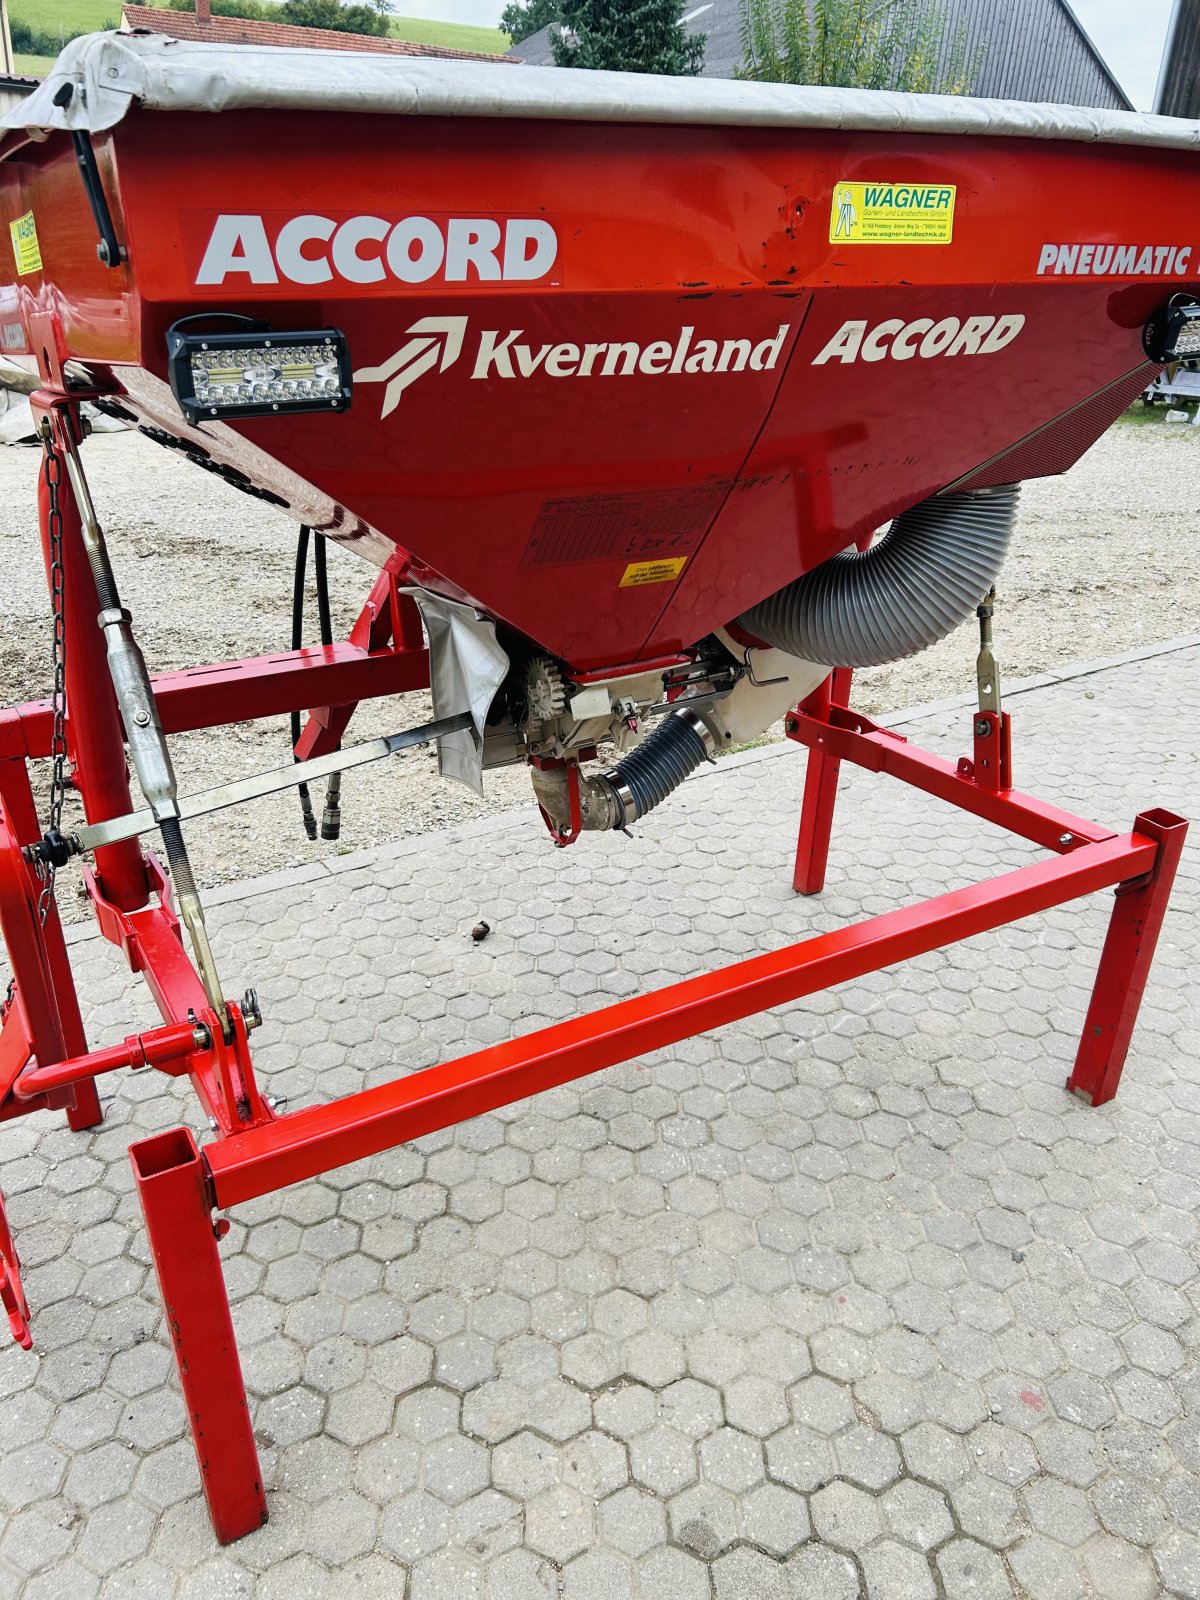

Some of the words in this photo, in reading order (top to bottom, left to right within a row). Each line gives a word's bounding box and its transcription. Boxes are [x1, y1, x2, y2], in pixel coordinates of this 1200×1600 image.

[864, 187, 951, 209] WAGNER
[195, 214, 558, 285] ACCORD
[1036, 244, 1192, 275] PNEUMATIC
[470, 324, 790, 380] Kverneland
[811, 314, 1026, 366] ACCORD
